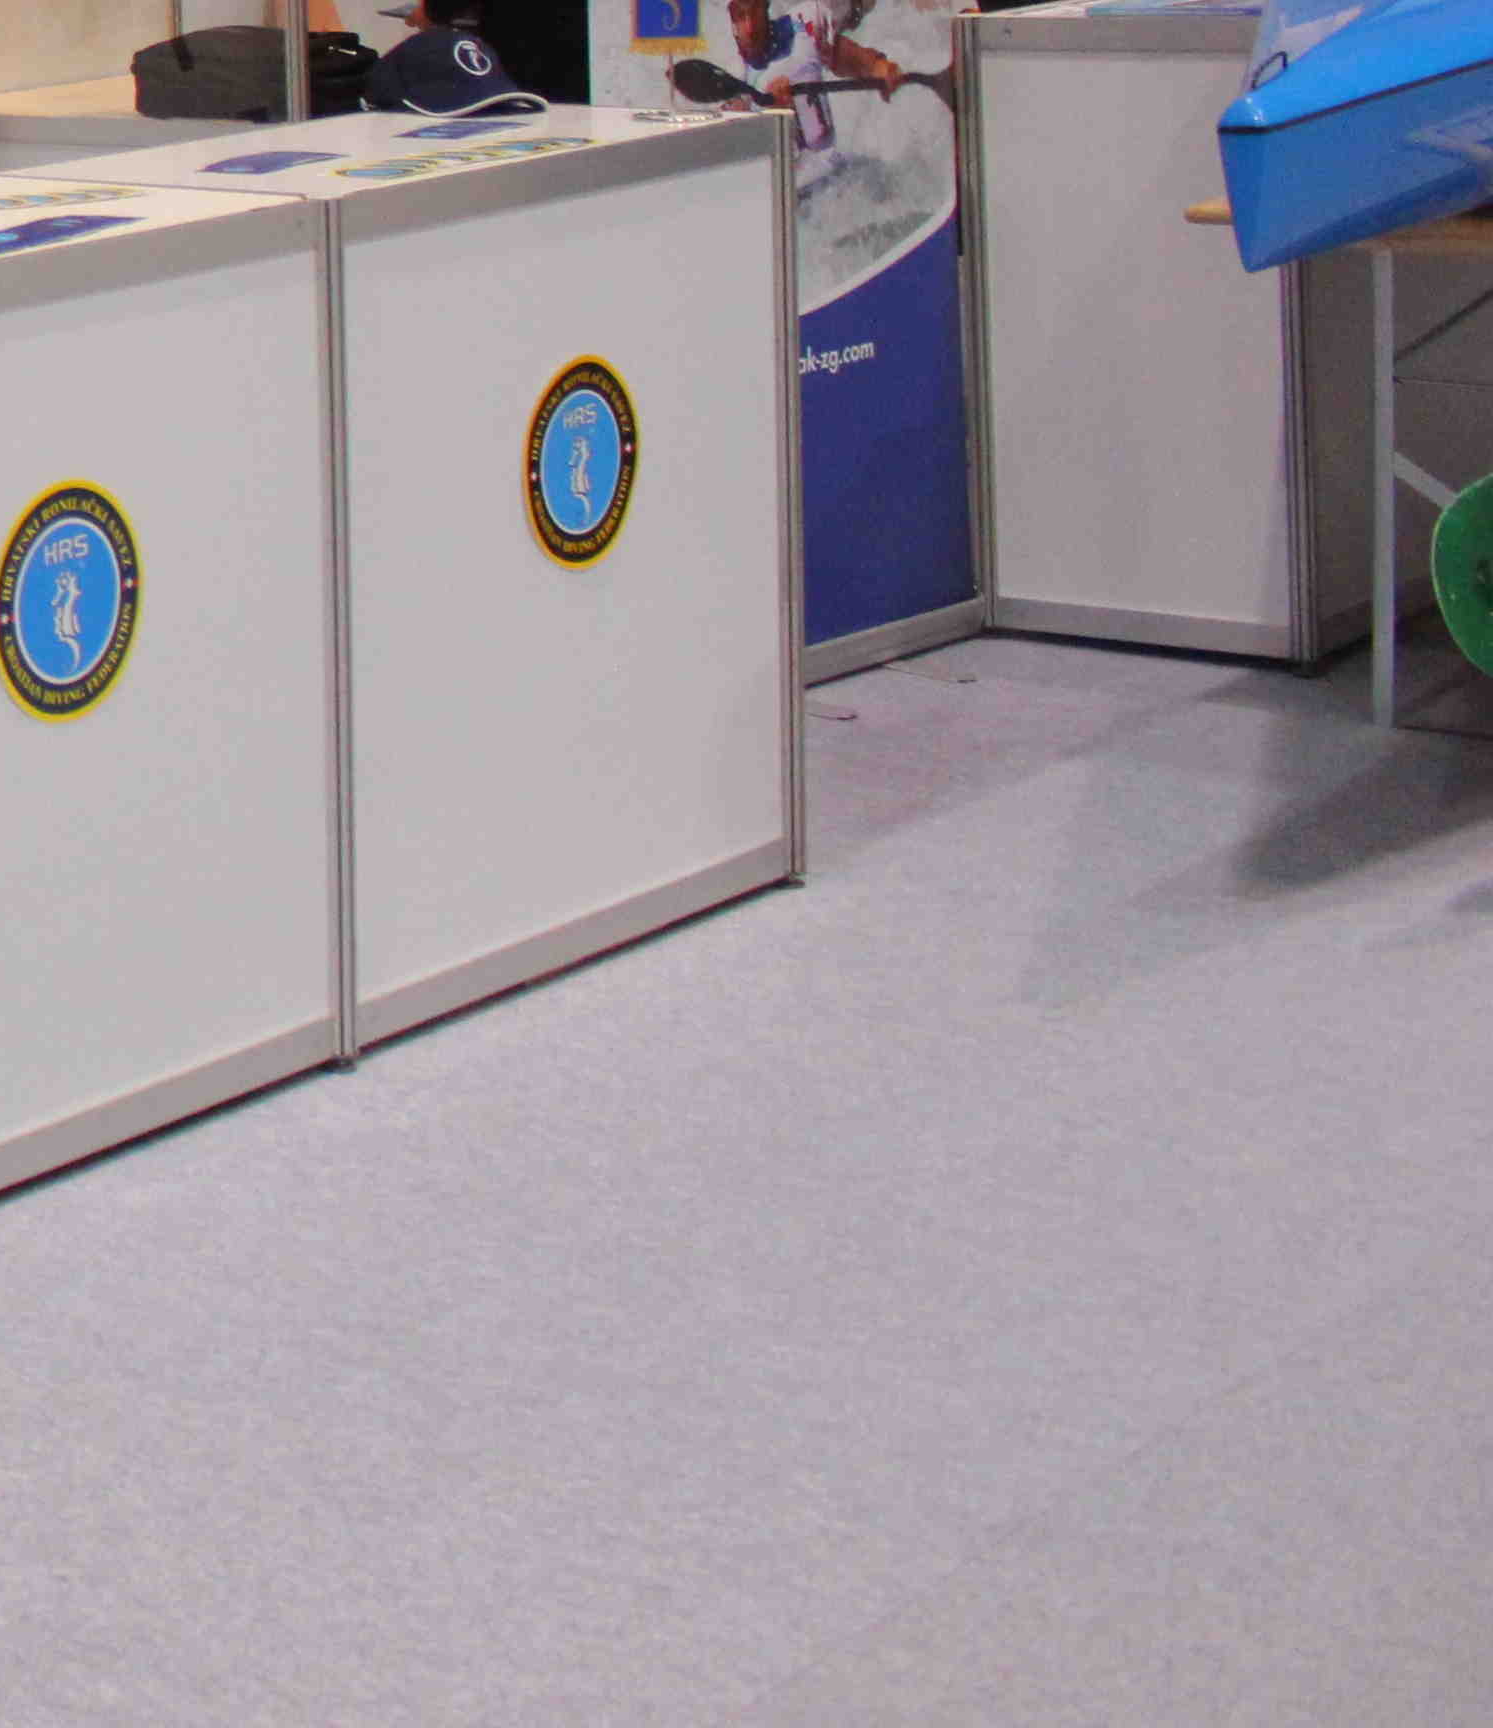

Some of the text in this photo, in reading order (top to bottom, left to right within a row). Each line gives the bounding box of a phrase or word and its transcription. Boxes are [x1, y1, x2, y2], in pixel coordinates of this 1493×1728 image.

[798, 341, 875, 374] ak-zg.com
[563, 402, 598, 429] HRS
[42, 533, 91, 568] HRS
